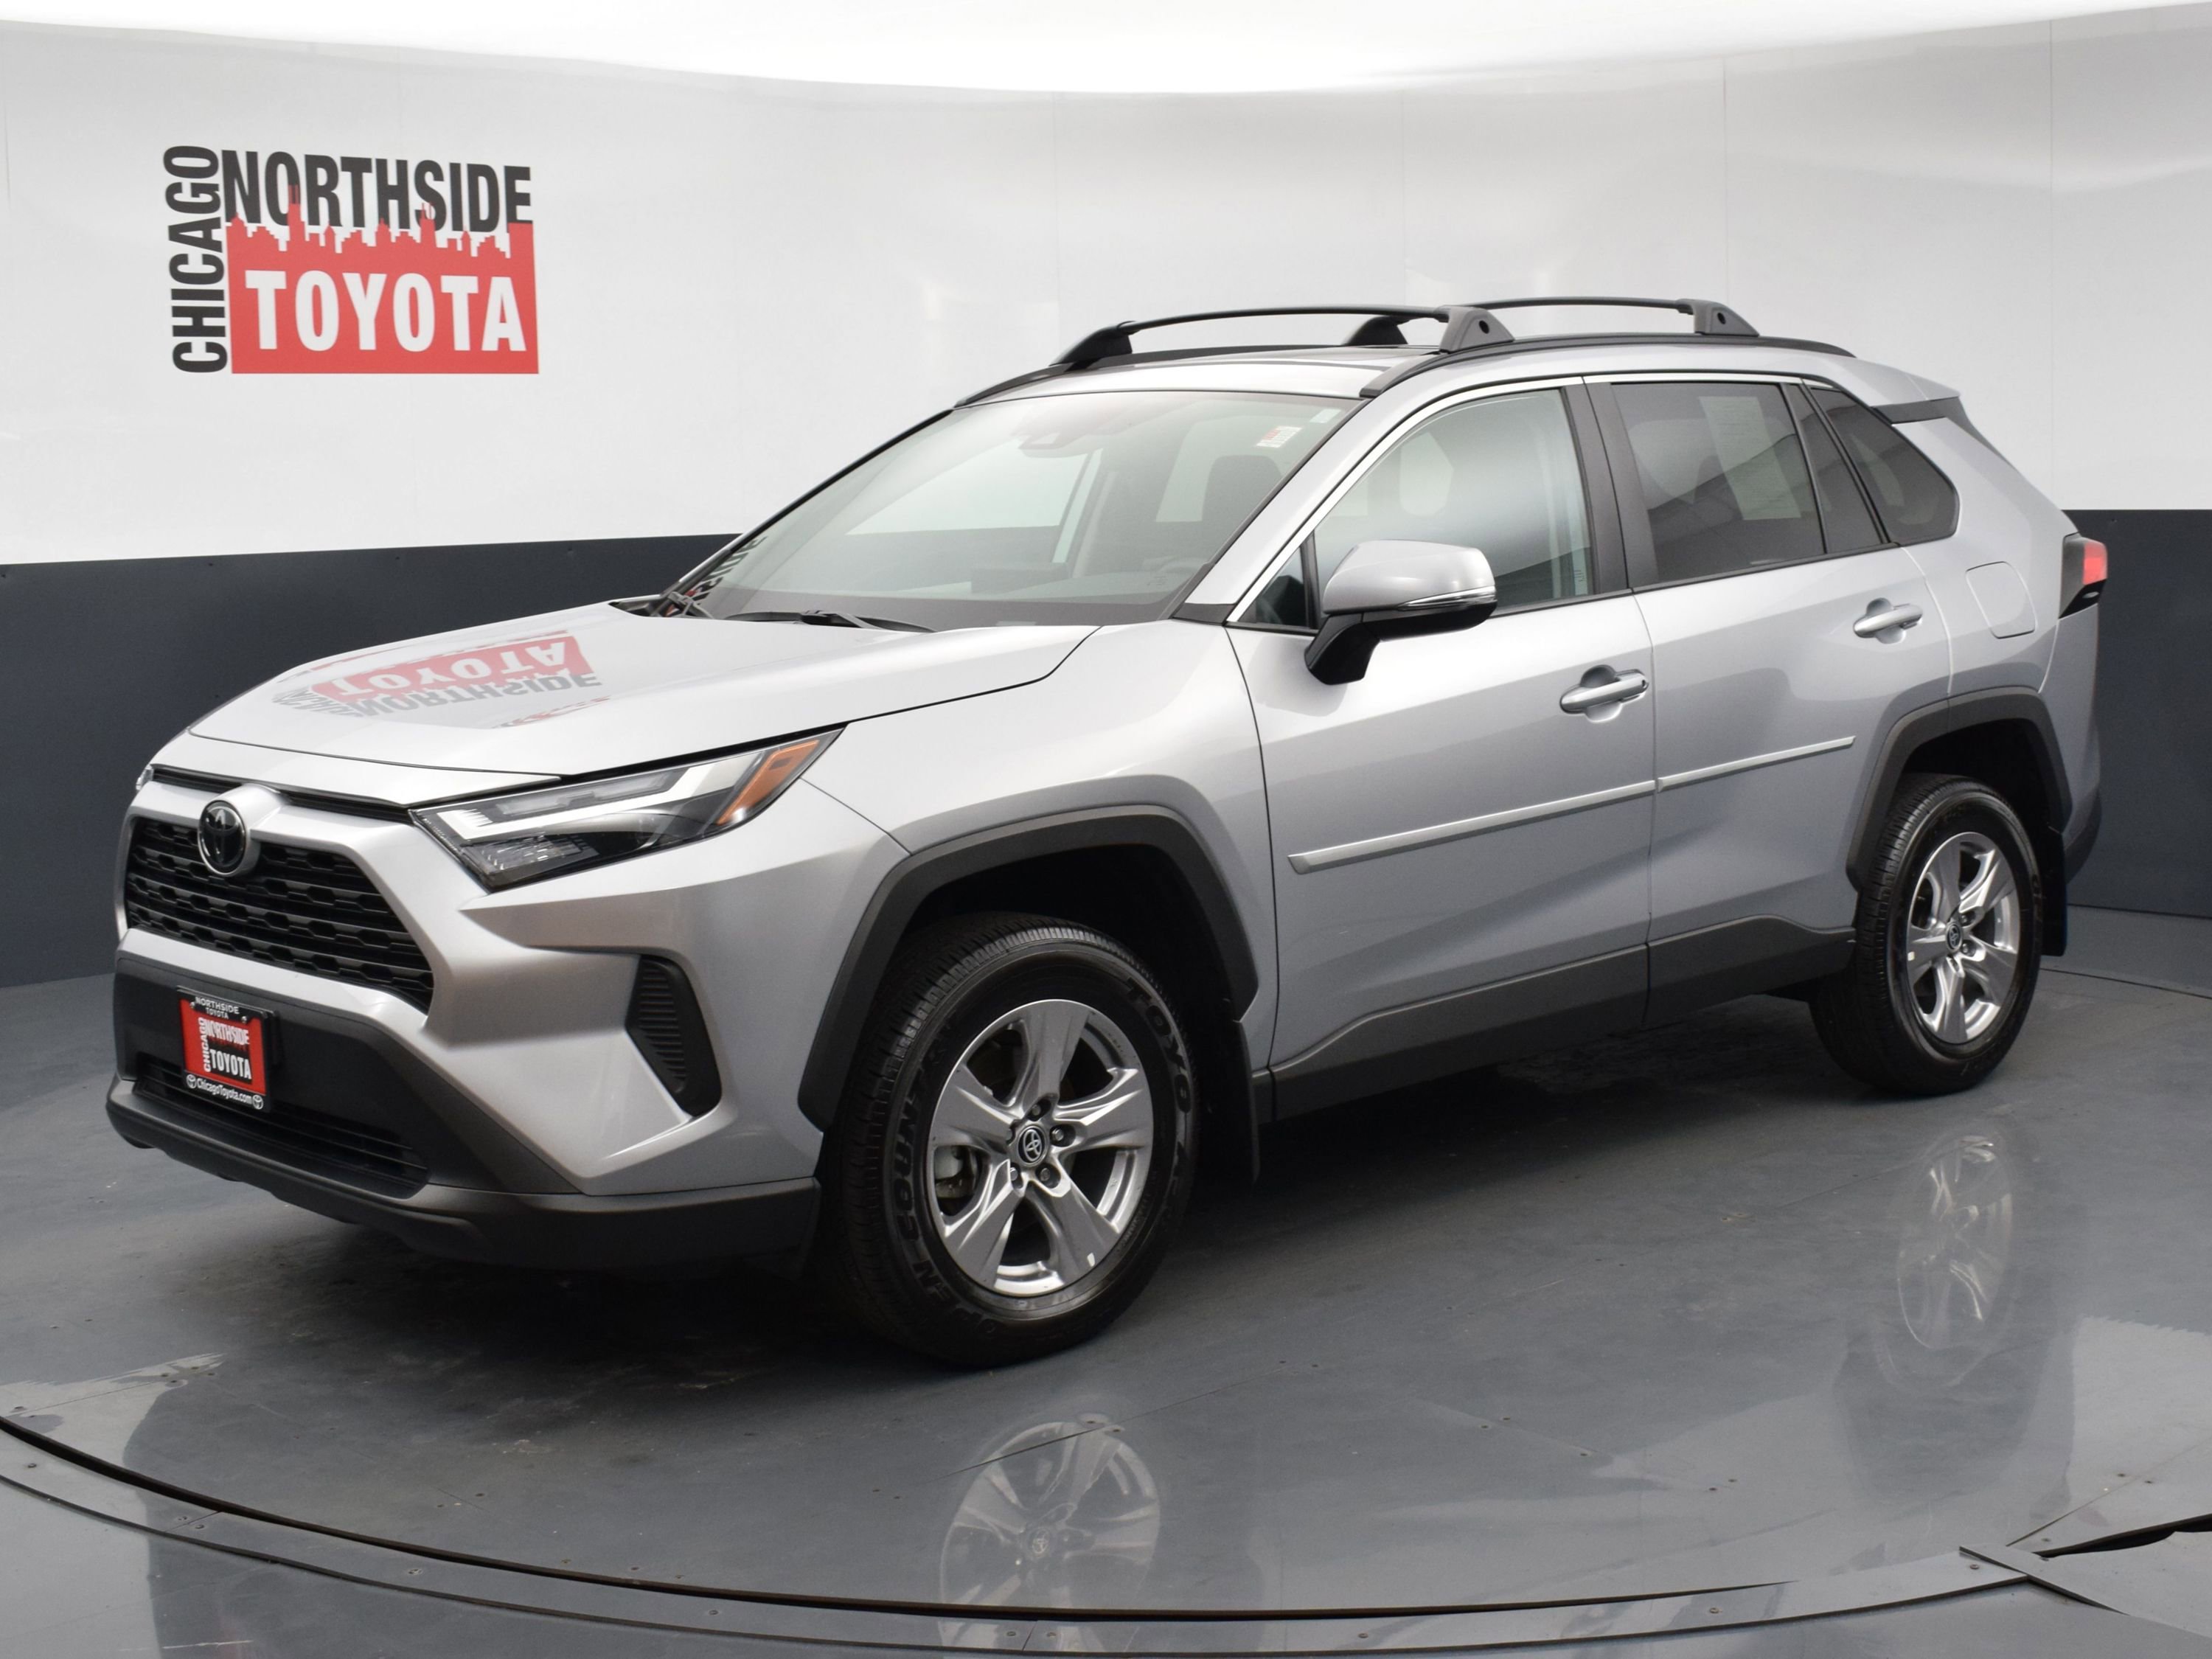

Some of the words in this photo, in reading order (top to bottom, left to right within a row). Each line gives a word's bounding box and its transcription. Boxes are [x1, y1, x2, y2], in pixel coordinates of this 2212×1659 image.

[221, 150, 533, 233] NORTHSIDE
[163, 145, 228, 373] CHICAGO
[245, 270, 526, 352] TOYOTA
[195, 997, 240, 1015] NORTHSIDE
[206, 1007, 229, 1019] TOYOTA
[198, 1017, 212, 1072] CHICAGO
[206, 1020, 249, 1045] NORTHSIDE
[210, 1048, 252, 1079] TOYOTA
[197, 1079, 253, 1104] ChicagoToyota.com
